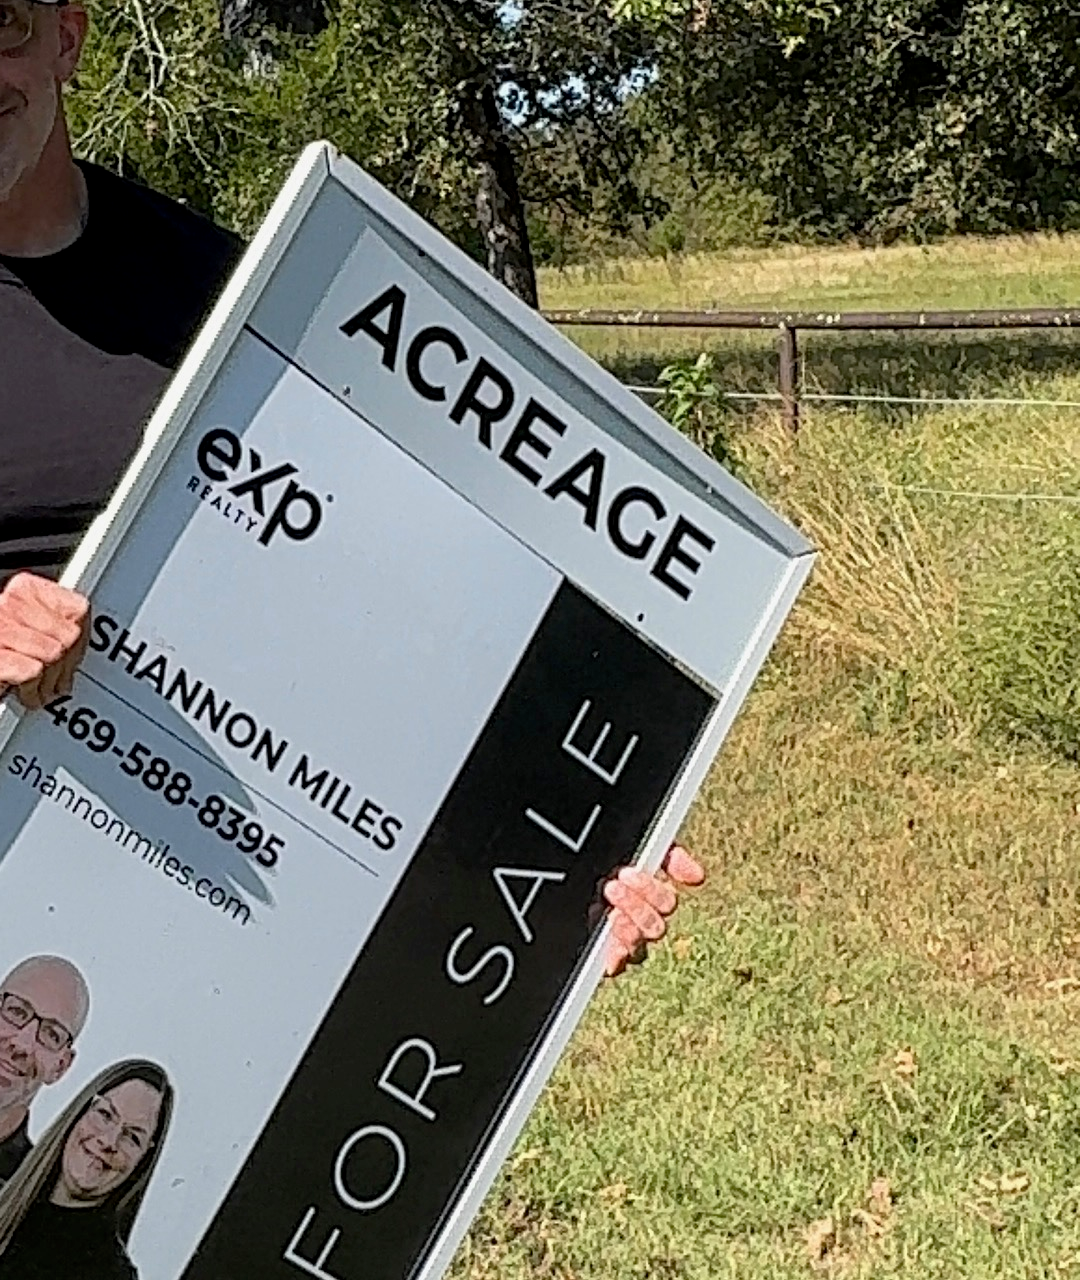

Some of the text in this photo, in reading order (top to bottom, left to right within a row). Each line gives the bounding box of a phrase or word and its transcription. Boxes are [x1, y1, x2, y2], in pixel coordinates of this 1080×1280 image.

[186, 475, 258, 532] REALTY
[339, 283, 716, 601] ACREAGE
[43, 694, 286, 868] 469-588-8395
[88, 614, 404, 852] SHANNON MILES
[8, 751, 253, 926] shannonmiles.com
[446, 698, 639, 1005] SALE
